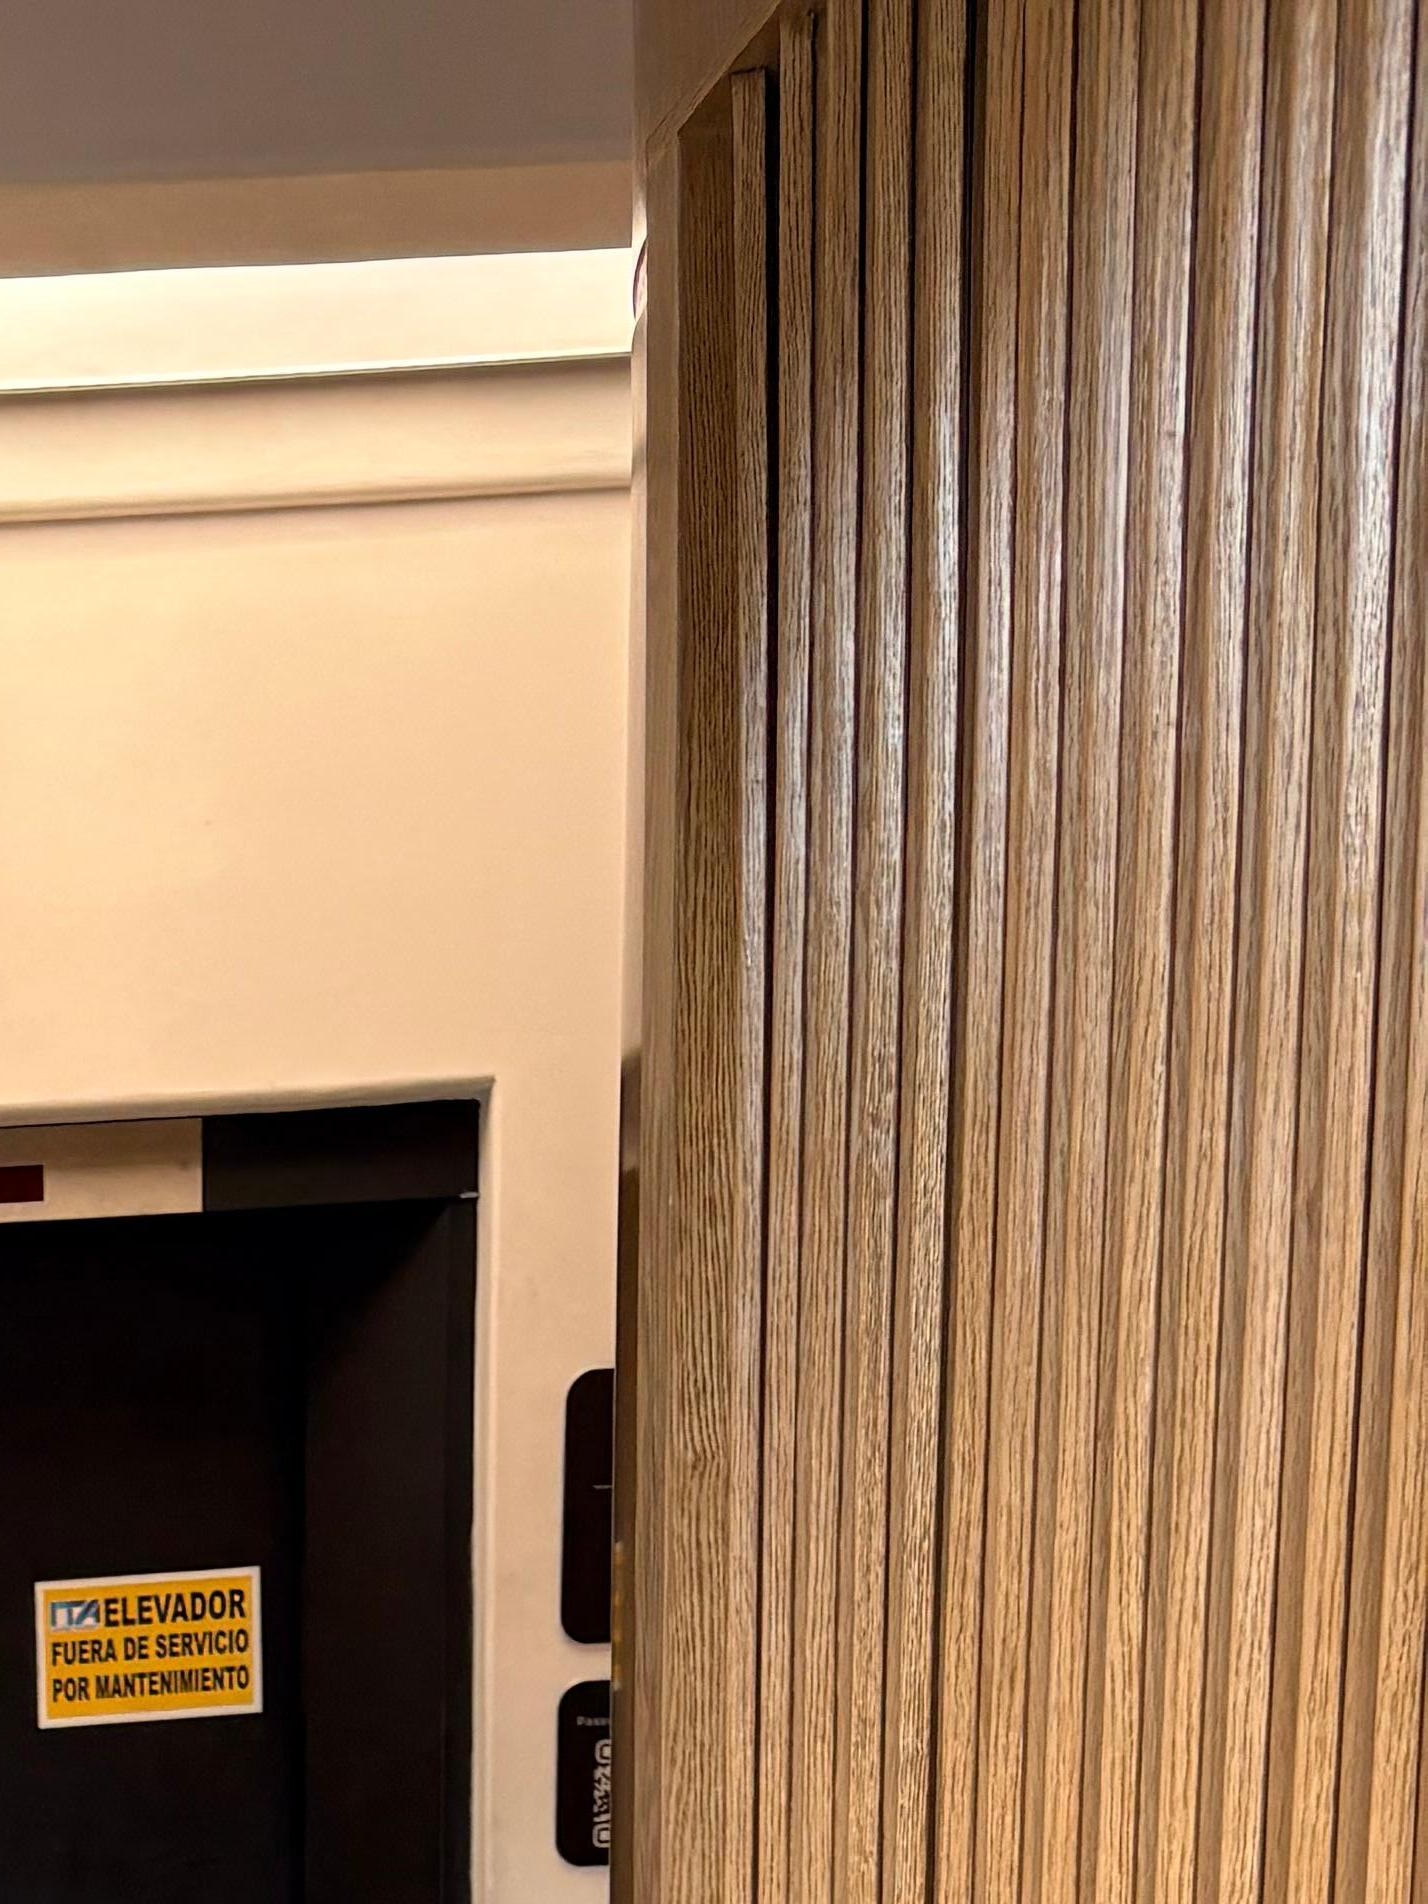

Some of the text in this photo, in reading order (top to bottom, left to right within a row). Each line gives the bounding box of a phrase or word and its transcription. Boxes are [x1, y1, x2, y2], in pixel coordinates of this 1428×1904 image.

[104, 1588, 246, 1628] ELEVADOR
[51, 1628, 249, 1666] FUERA DE SERVICIO
[52, 1664, 250, 1702] POR MANTENIMIENTO
